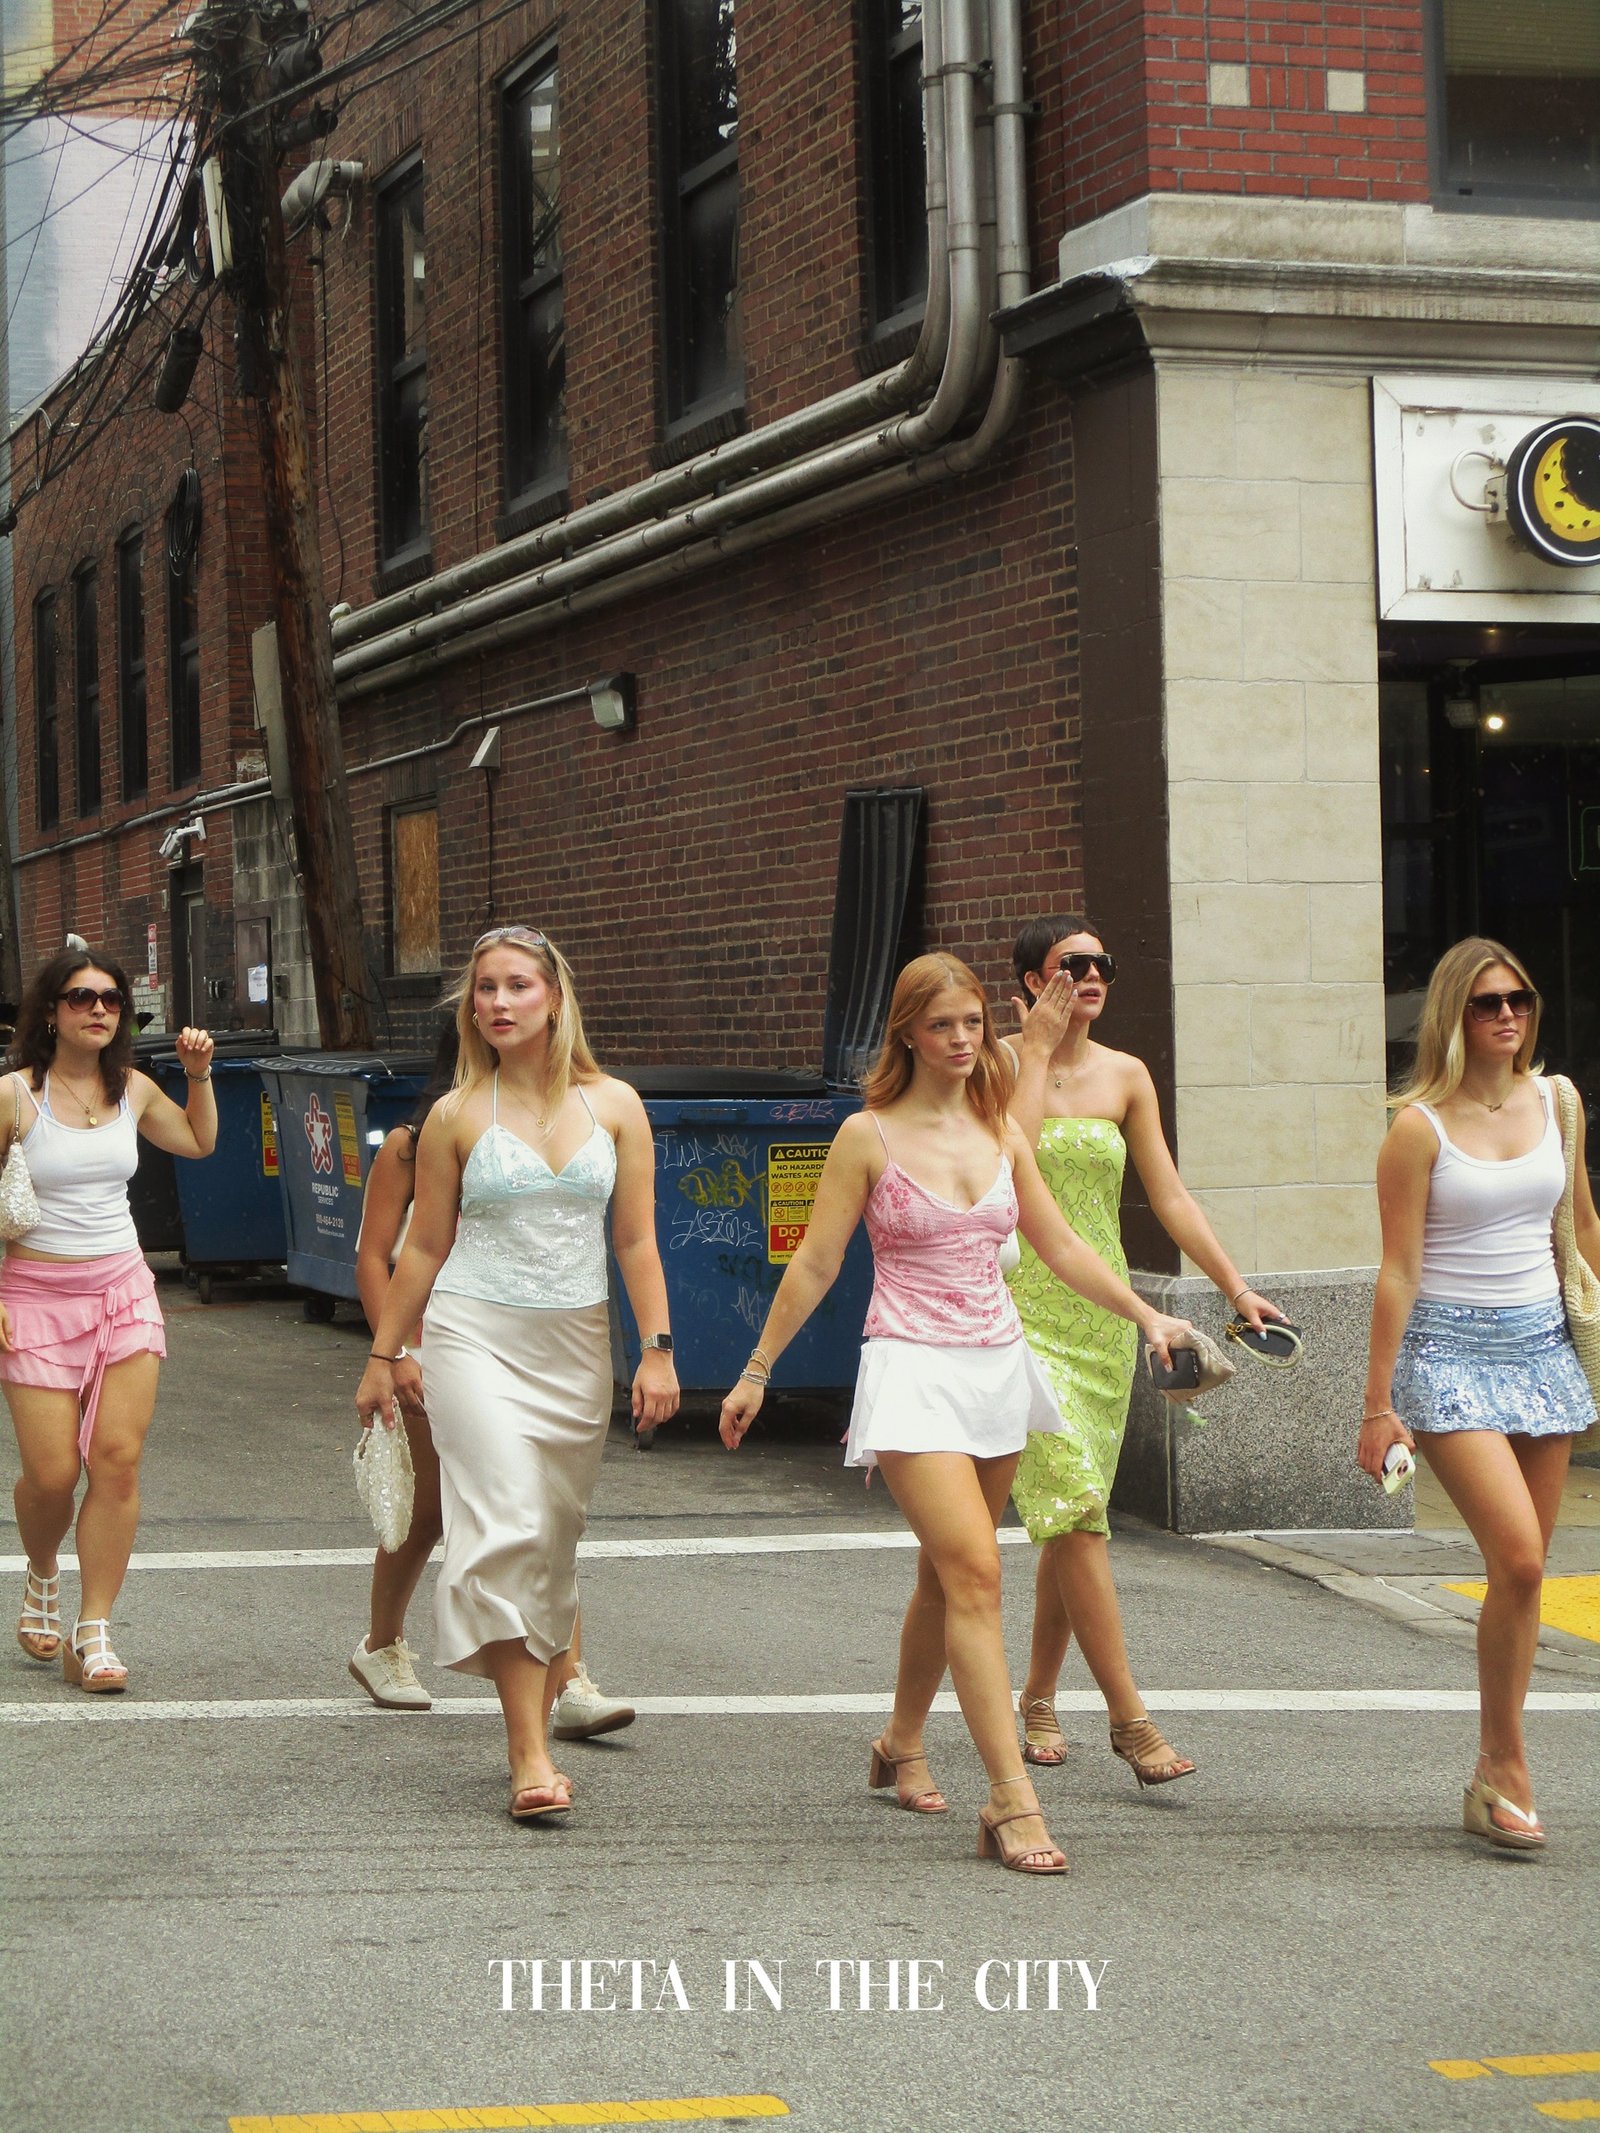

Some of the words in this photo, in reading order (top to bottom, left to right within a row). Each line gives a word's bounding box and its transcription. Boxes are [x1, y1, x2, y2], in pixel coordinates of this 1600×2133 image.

[786, 1149, 830, 1158] CAUTIO
[311, 1182, 339, 1198] REPUBLIC
[778, 1227, 800, 1237] DO
